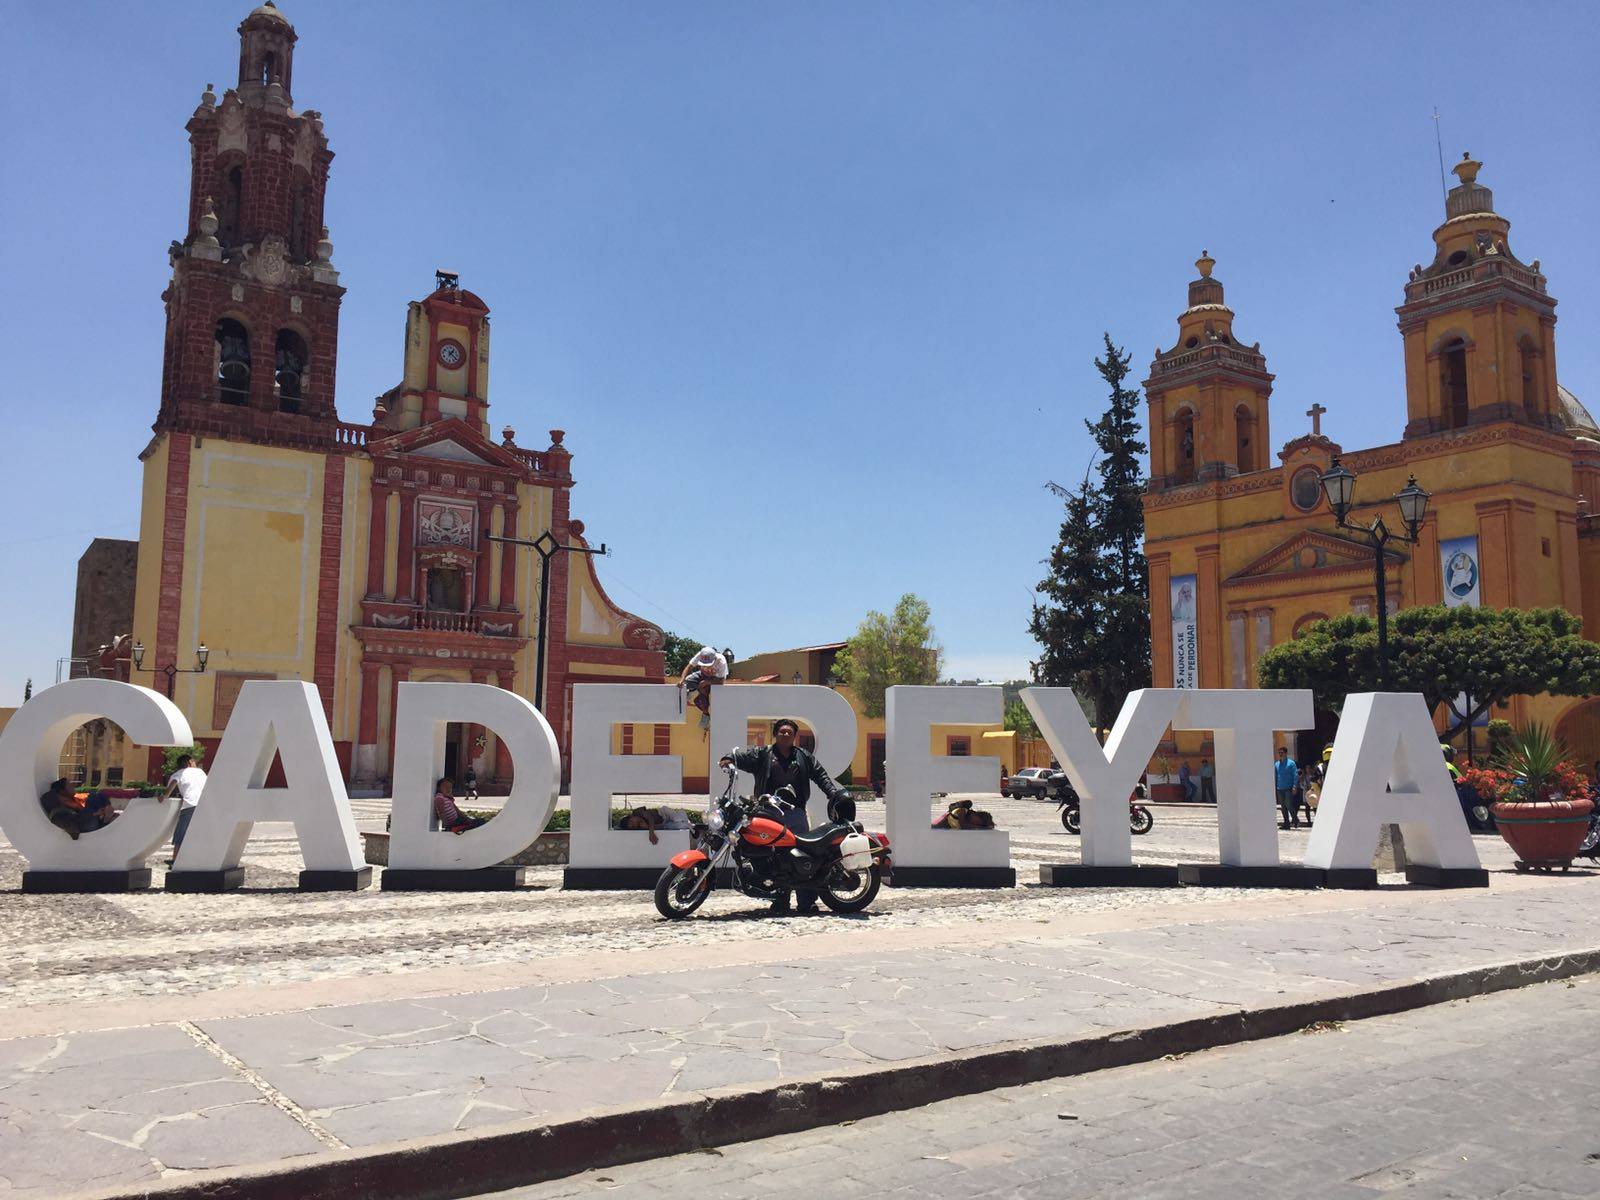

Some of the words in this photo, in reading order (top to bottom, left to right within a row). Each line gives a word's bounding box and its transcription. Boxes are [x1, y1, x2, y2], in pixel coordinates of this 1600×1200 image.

[1177, 632, 1184, 643] SE
[1187, 624, 1196, 671] PERDONAR
[1187, 672, 1193, 681] DE
[0, 678, 1482, 871] CADEREYTA
